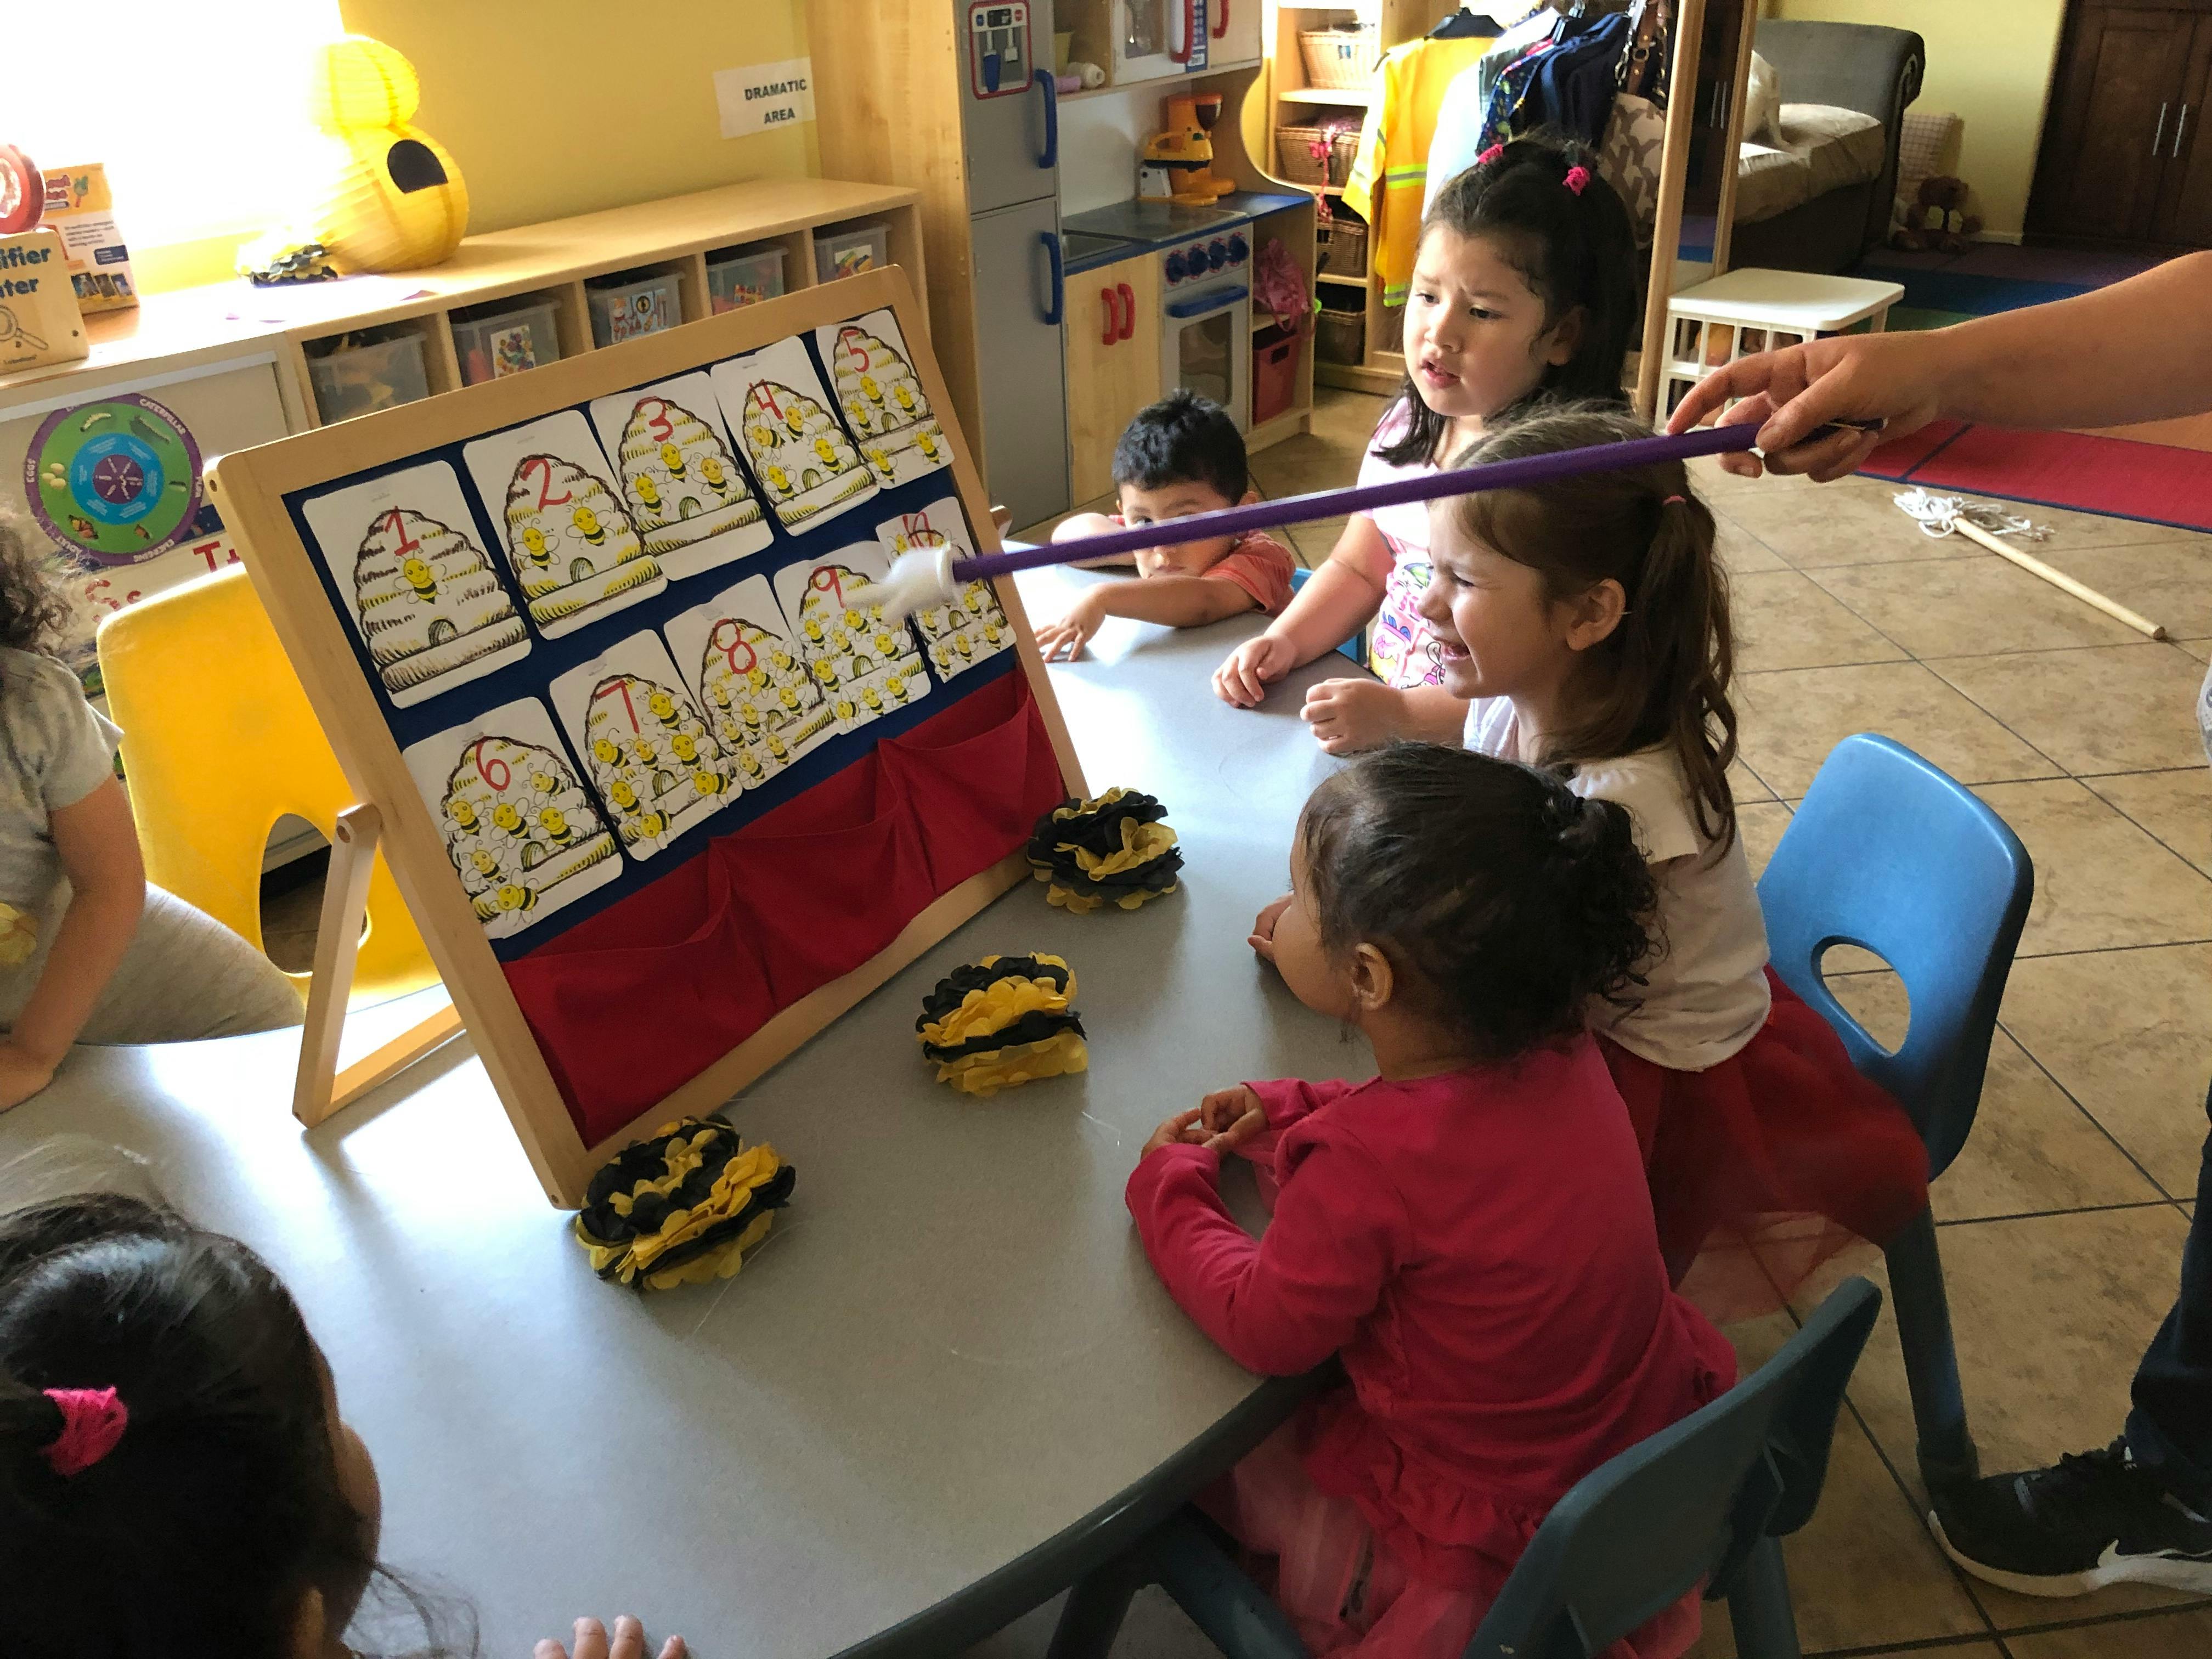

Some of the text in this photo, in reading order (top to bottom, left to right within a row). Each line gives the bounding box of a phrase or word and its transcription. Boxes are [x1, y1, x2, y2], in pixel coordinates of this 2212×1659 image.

[744, 78, 807, 101] DRAMATIC
[764, 107, 795, 124] AREA
[0, 246, 51, 270] ifier
[384, 330, 870, 556] 1 2 3 4 5
[26, 458, 36, 483] EGGS
[475, 736, 511, 791] 6
[594, 679, 640, 733] 7
[713, 618, 757, 674] 8
[812, 566, 847, 608] 9
